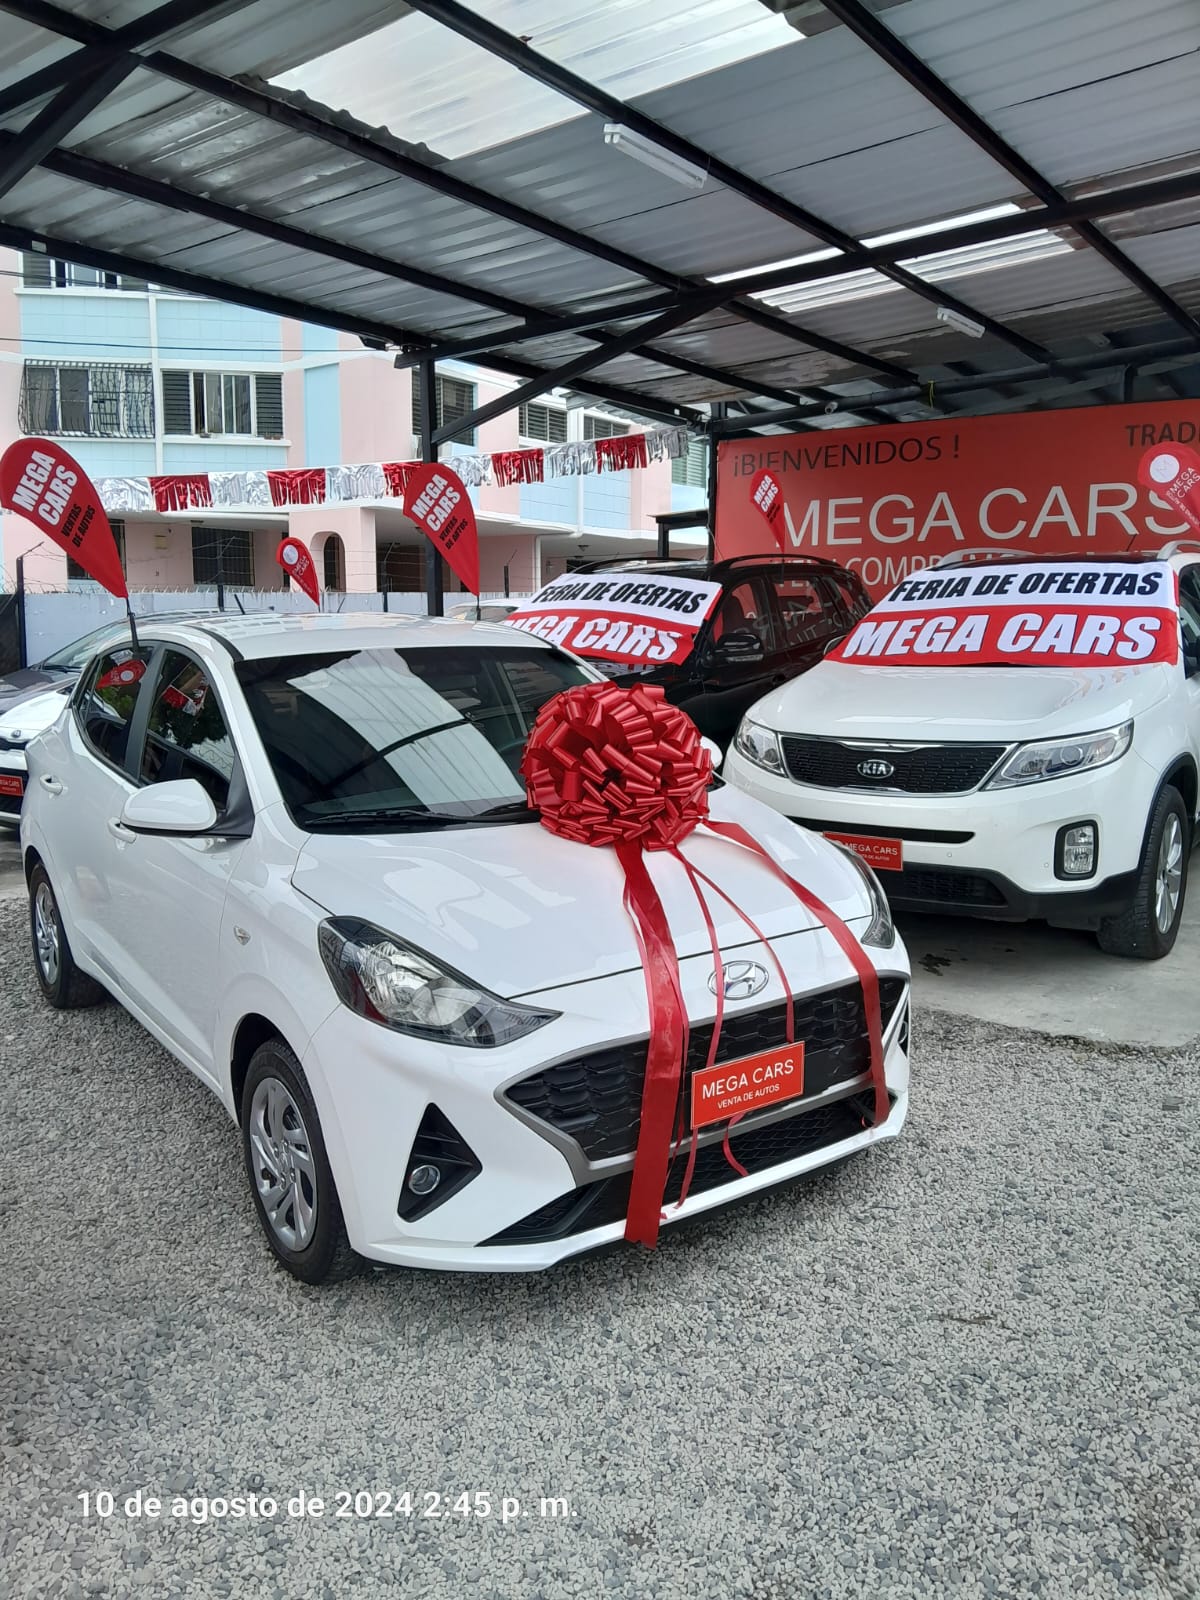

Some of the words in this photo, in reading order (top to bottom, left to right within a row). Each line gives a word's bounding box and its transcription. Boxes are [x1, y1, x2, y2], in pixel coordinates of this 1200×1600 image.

[1126, 422, 1200, 447] TRAD
[12, 450, 56, 512] MEGA
[38, 465, 78, 526] CARS
[411, 474, 448, 520] MEGA
[61, 503, 82, 537] VENTAS
[77, 504, 96, 536] AUTOS
[426, 486, 461, 532] CARS
[776, 491, 965, 548] MEGA
[978, 482, 1191, 539] CARS
[72, 533, 83, 548] DE
[531, 583, 591, 604] FERIA
[580, 582, 617, 601] DE
[614, 583, 708, 614] OFERTAS
[888, 576, 972, 602] FERIA
[972, 573, 1018, 597] DE
[1018, 571, 1163, 597] OFERTAS
[571, 617, 682, 661] CARS
[841, 613, 990, 659] MEGA
[997, 612, 1163, 661] CARS
[862, 763, 887, 775] KIA
[873, 845, 898, 856] CARS
[702, 1073, 749, 1100] MEGA
[752, 1059, 794, 1084] CARS
[717, 1096, 743, 1109] VENTA
[743, 1093, 754, 1102] DE
[754, 1083, 780, 1097] AUTOS
